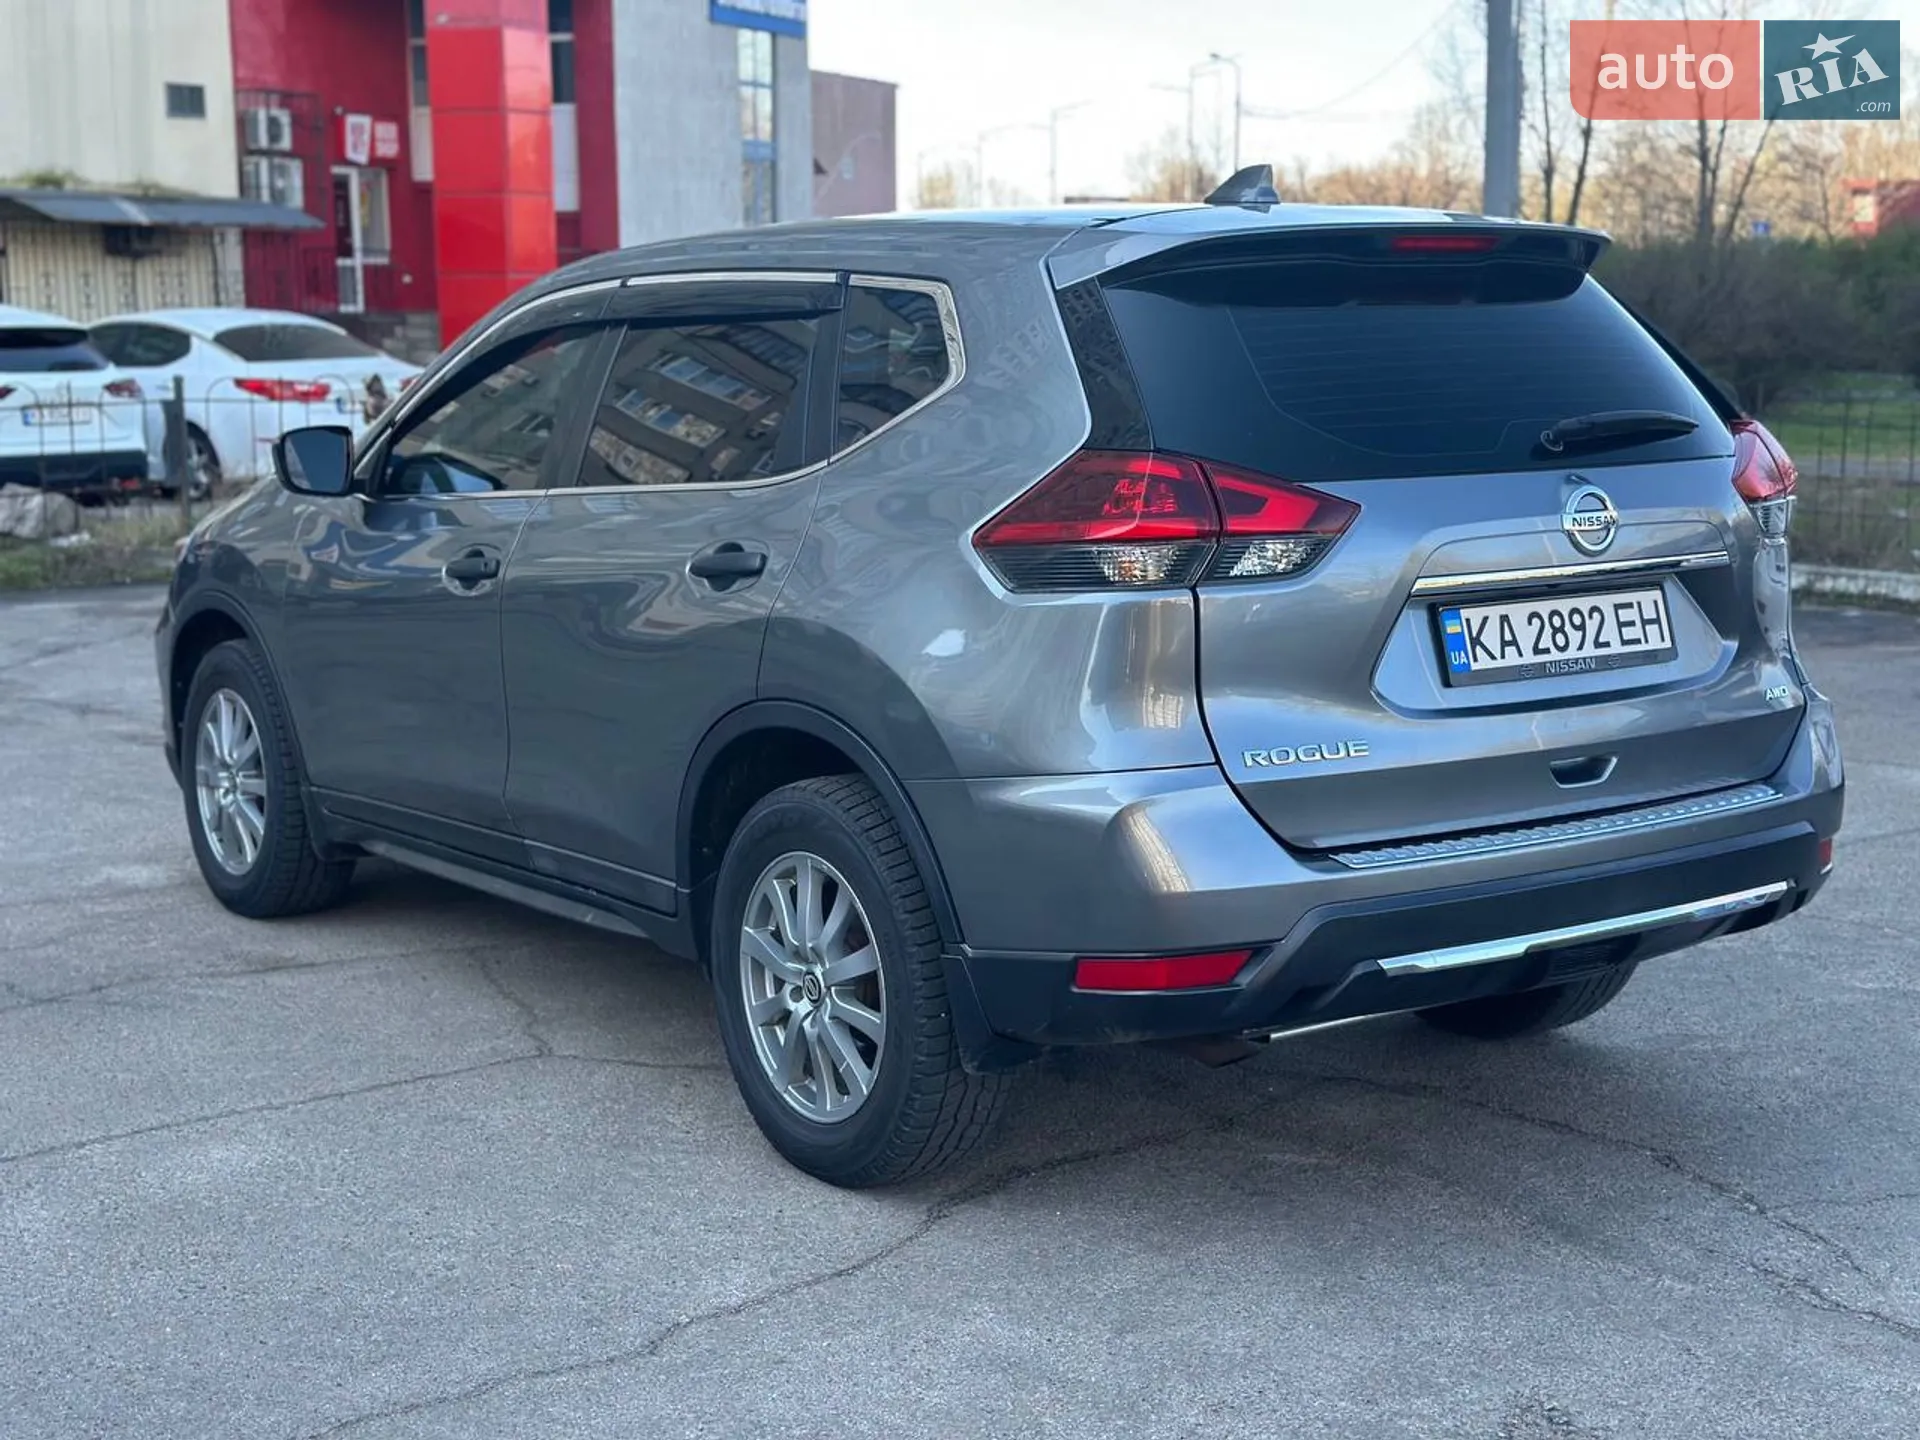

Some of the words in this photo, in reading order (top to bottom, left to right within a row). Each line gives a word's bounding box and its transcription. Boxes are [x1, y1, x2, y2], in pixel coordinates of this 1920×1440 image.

[1572, 515, 1615, 527] NISSAN
[1465, 614, 1523, 663] KA
[1527, 605, 1610, 656] 2892
[1613, 600, 1665, 646] EH
[1451, 651, 1468, 665] UA
[1545, 657, 1596, 673] NISSAN
[1765, 686, 1788, 701] AWD
[1242, 740, 1369, 768] ROGUE
